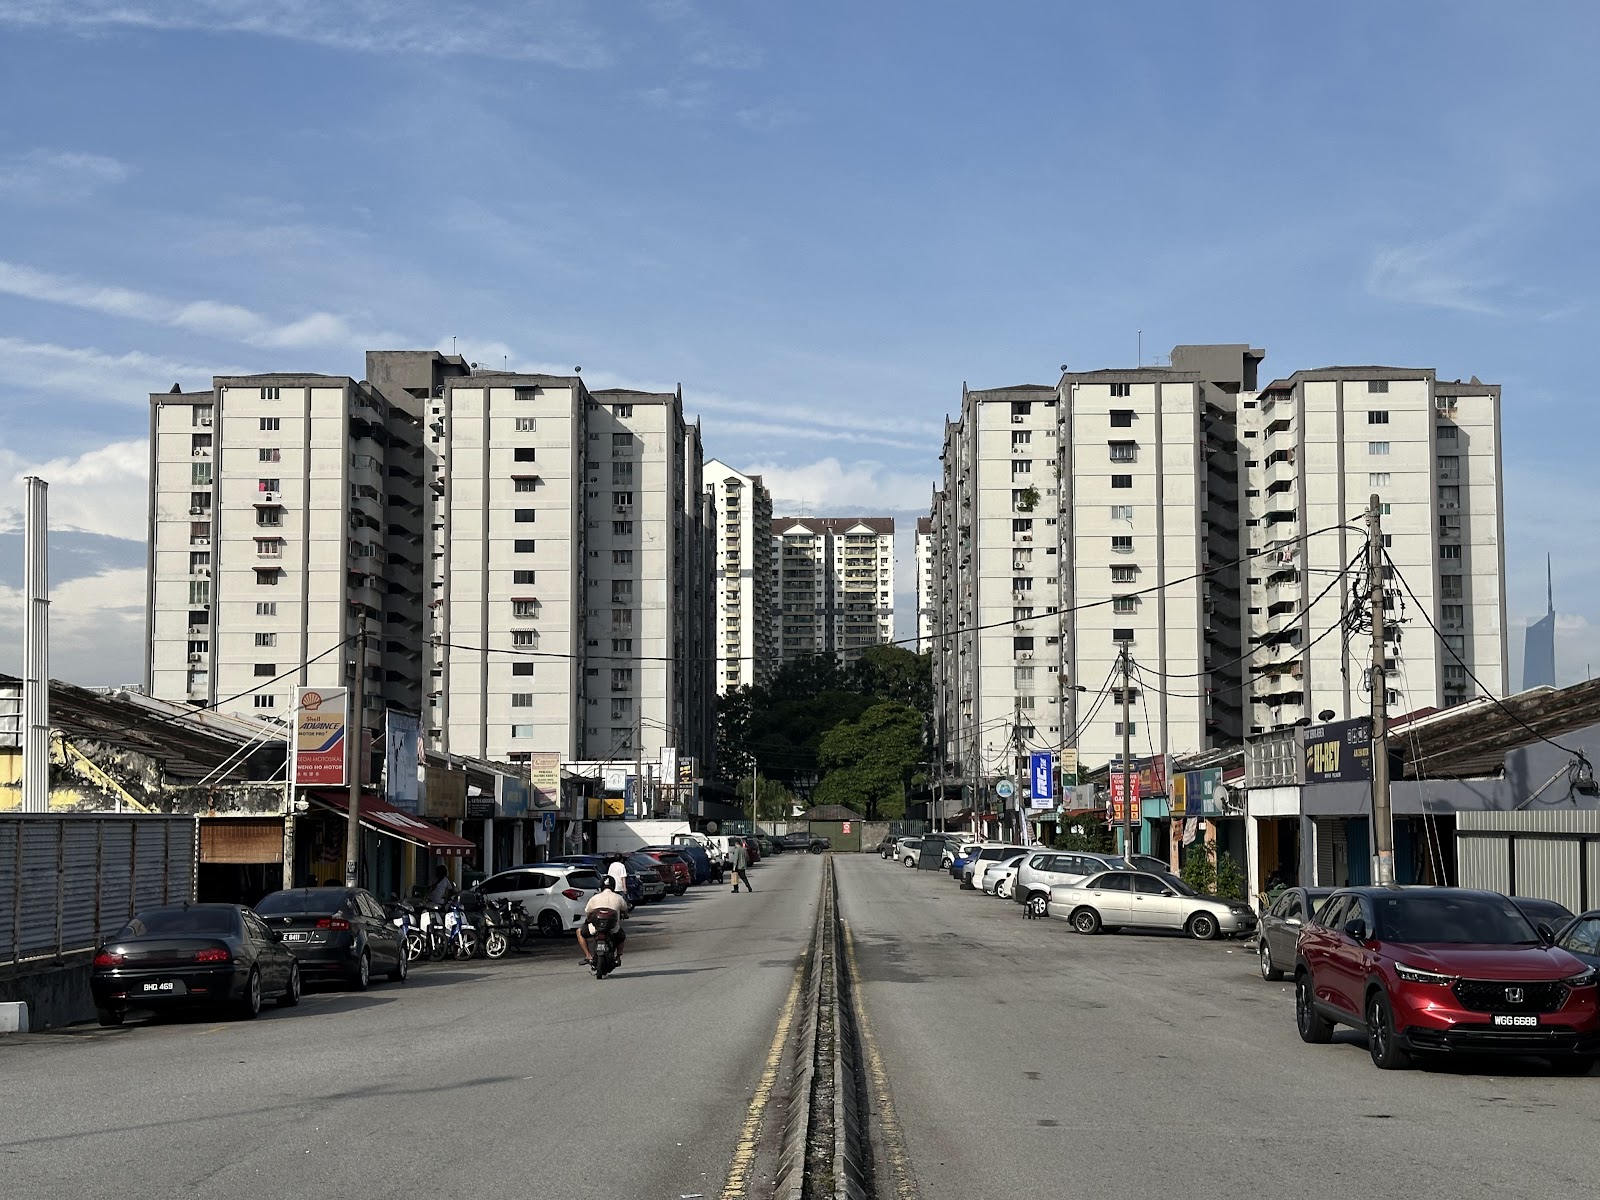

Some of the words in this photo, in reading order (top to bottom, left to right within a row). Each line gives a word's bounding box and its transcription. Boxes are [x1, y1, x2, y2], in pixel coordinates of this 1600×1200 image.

[1314, 741, 1340, 773] HI-REV
[159, 982, 173, 990] 469
[1494, 1015, 1513, 1025] WGG
[1514, 1016, 1537, 1026] 6688
